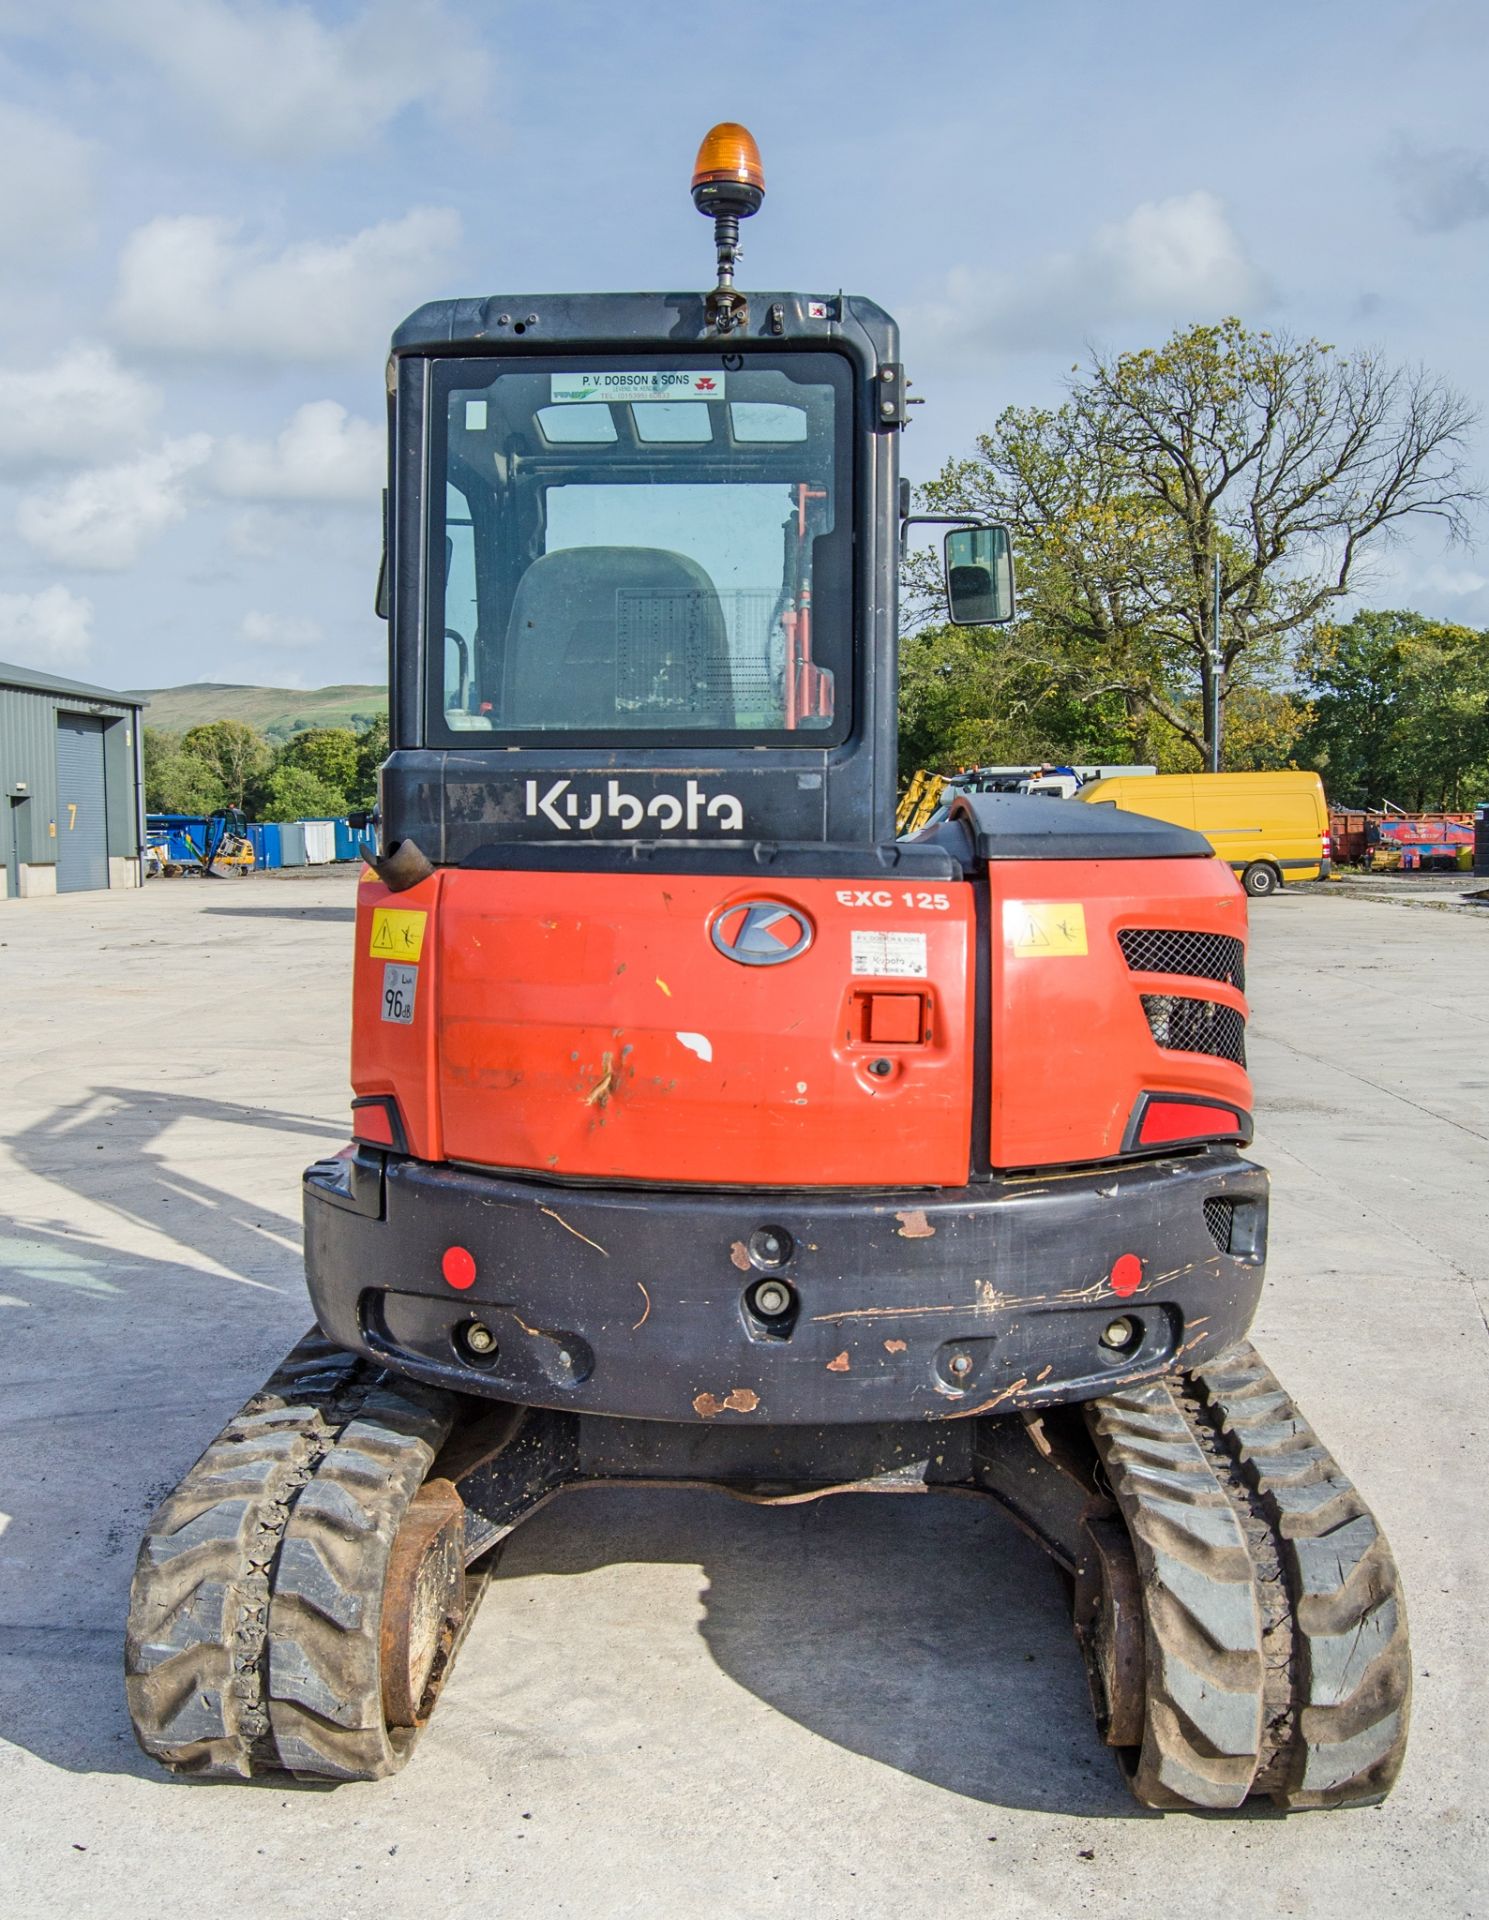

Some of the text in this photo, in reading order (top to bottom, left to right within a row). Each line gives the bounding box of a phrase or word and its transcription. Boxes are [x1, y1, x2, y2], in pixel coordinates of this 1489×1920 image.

[582, 374, 690, 386] P. V. DOBSON & SONS
[66, 803, 78, 831] 7
[526, 780, 743, 830] Kubota
[835, 890, 950, 911] EXC 125
[385, 988, 404, 1018] 96
